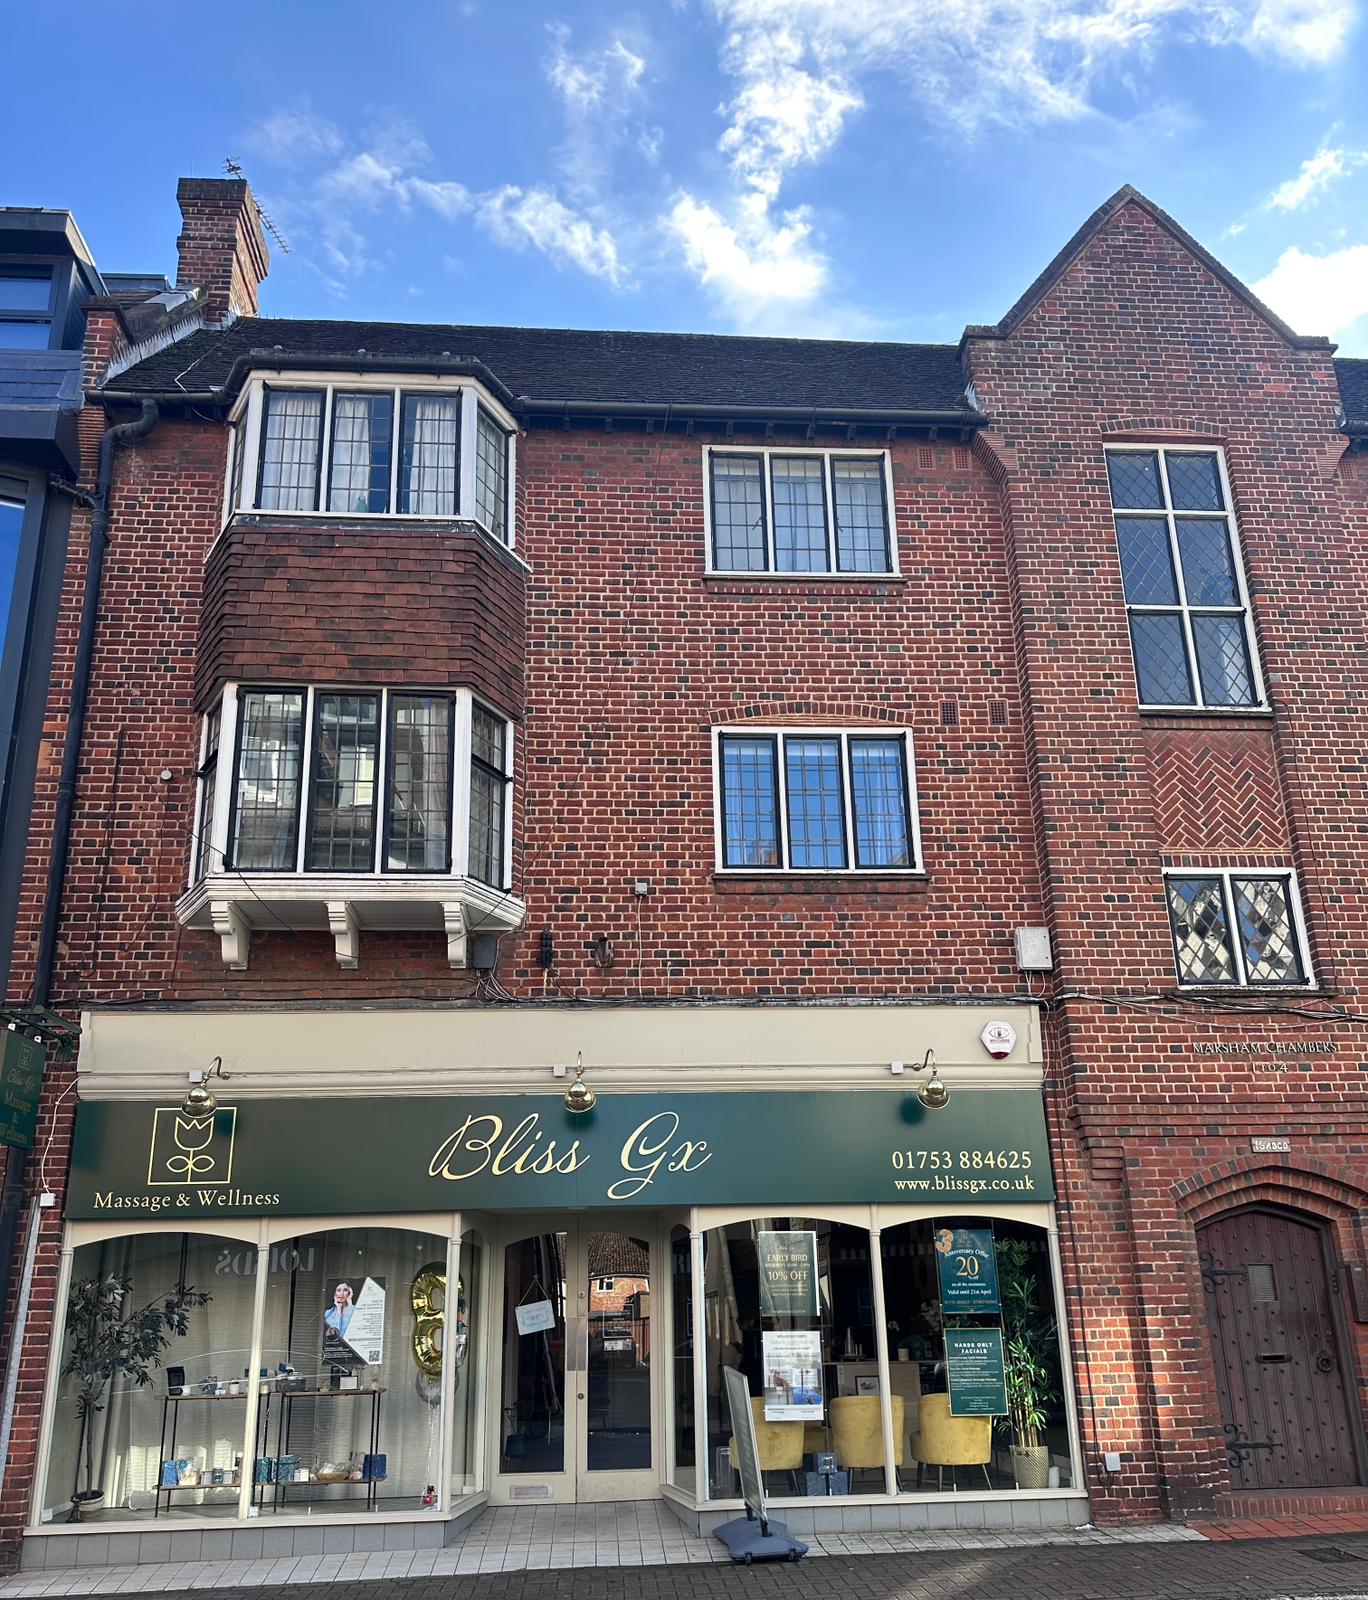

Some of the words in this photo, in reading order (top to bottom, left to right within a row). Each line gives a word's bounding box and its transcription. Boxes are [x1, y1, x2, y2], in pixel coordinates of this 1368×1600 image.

[1192, 1042, 1260, 1054] MARSHAM
[1265, 1041, 1337, 1053] CHAMBERS
[1280, 1062, 1288, 1073] 4
[4, 1089, 31, 1115] Massage
[428, 1113, 590, 1181] Bliss
[607, 1111, 712, 1200] Gx
[892, 1151, 952, 1169] 01753
[959, 1150, 1032, 1169] 884625
[894, 1175, 1035, 1194] www.blissgx.co.uk
[93, 1192, 171, 1212] Massage
[176, 1193, 191, 1207] &
[197, 1189, 280, 1207] Wellness
[767, 1254, 790, 1262] EARLY
[790, 1254, 808, 1262] BIRD
[956, 1256, 978, 1276] 20
[768, 1271, 788, 1280] 10%
[790, 1270, 809, 1280] OFF
